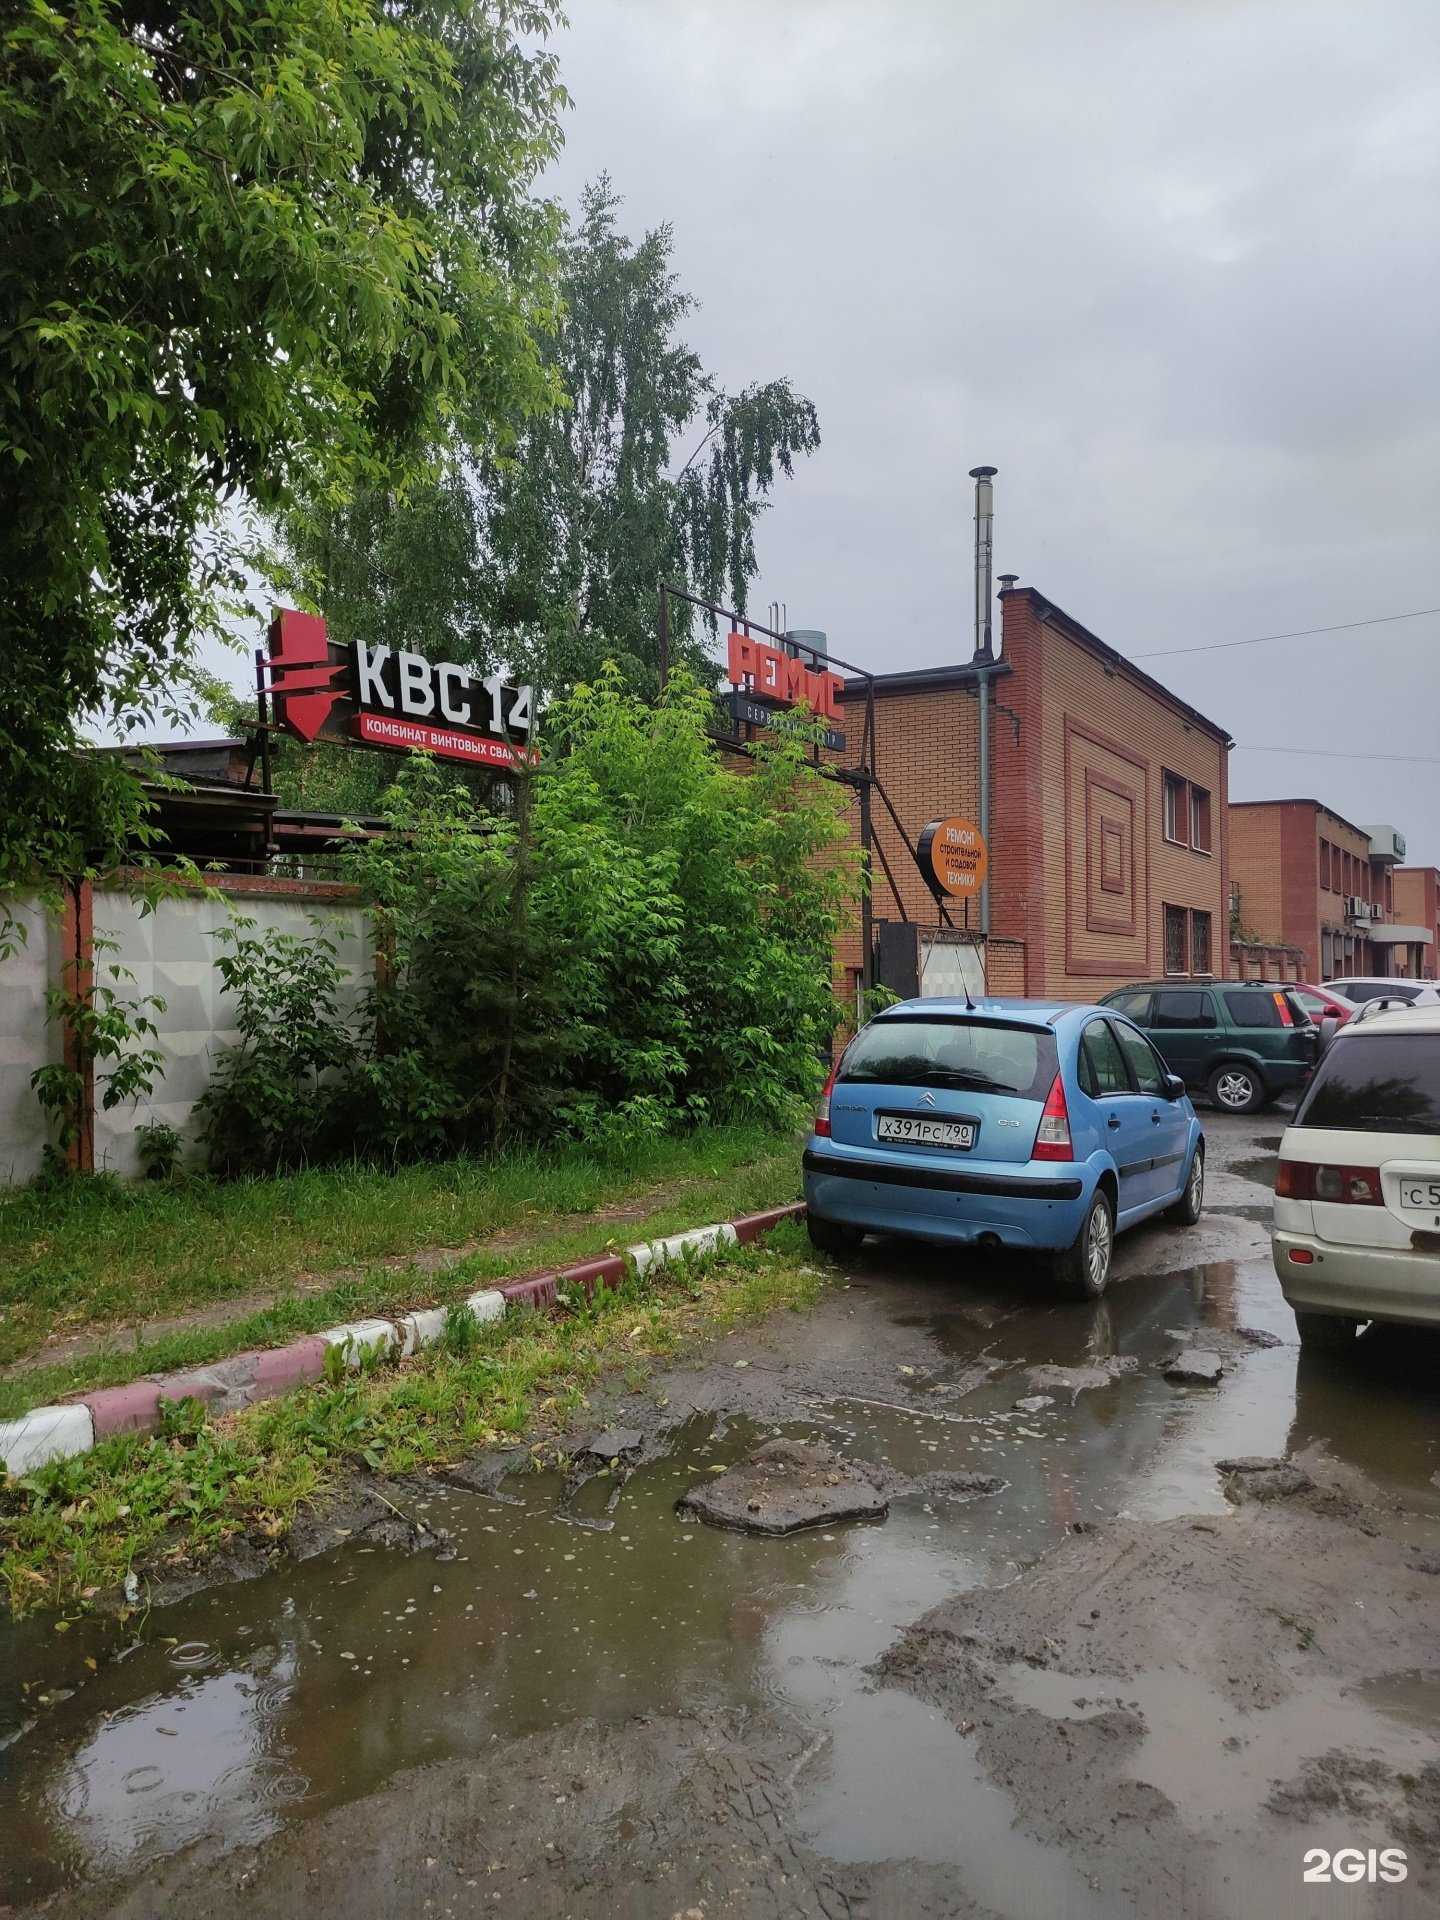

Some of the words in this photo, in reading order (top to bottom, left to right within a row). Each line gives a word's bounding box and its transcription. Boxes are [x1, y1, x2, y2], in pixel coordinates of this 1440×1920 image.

[357, 640, 471, 724] КВС
[483, 675, 539, 734] 14
[366, 718, 428, 743] КОМБИНАТ
[431, 732, 487, 755] ВИНТОВЫХ
[946, 827, 976, 845] РЕМОНТ
[947, 871, 976, 887] ТЕХНИКИ
